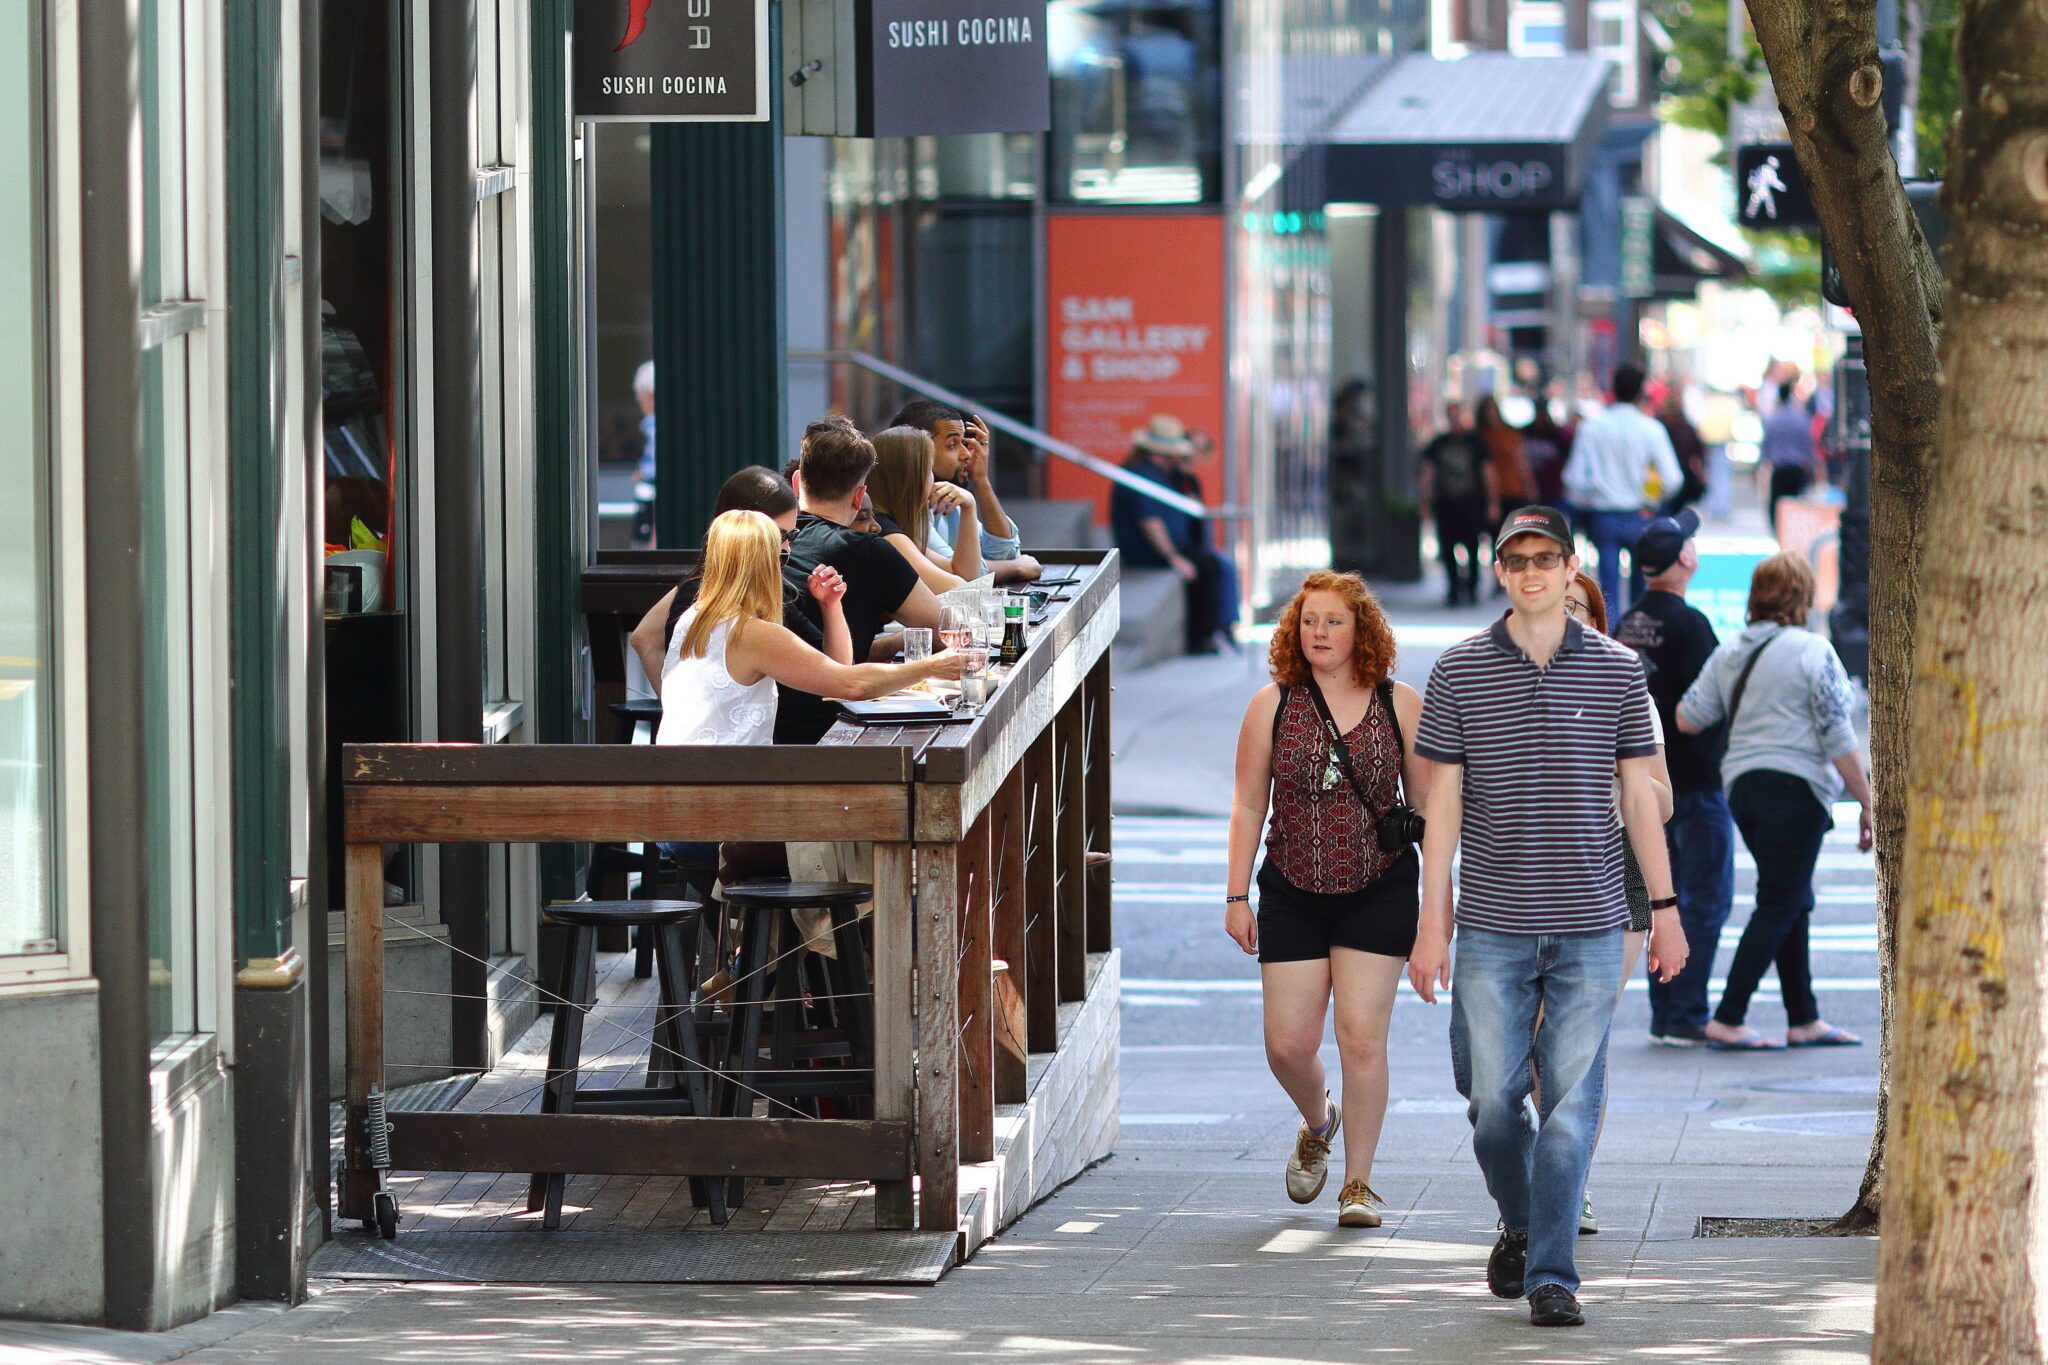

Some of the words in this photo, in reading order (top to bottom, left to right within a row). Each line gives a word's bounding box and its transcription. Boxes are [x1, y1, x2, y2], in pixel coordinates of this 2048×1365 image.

[888, 20, 949, 48] SUSHI
[957, 16, 1033, 46] COCINA
[602, 76, 653, 95] SUSHI
[662, 76, 728, 95] COCINA
[1431, 160, 1553, 200] SHOP
[1061, 297, 1133, 322] SAM
[1061, 324, 1209, 351] GALLERY
